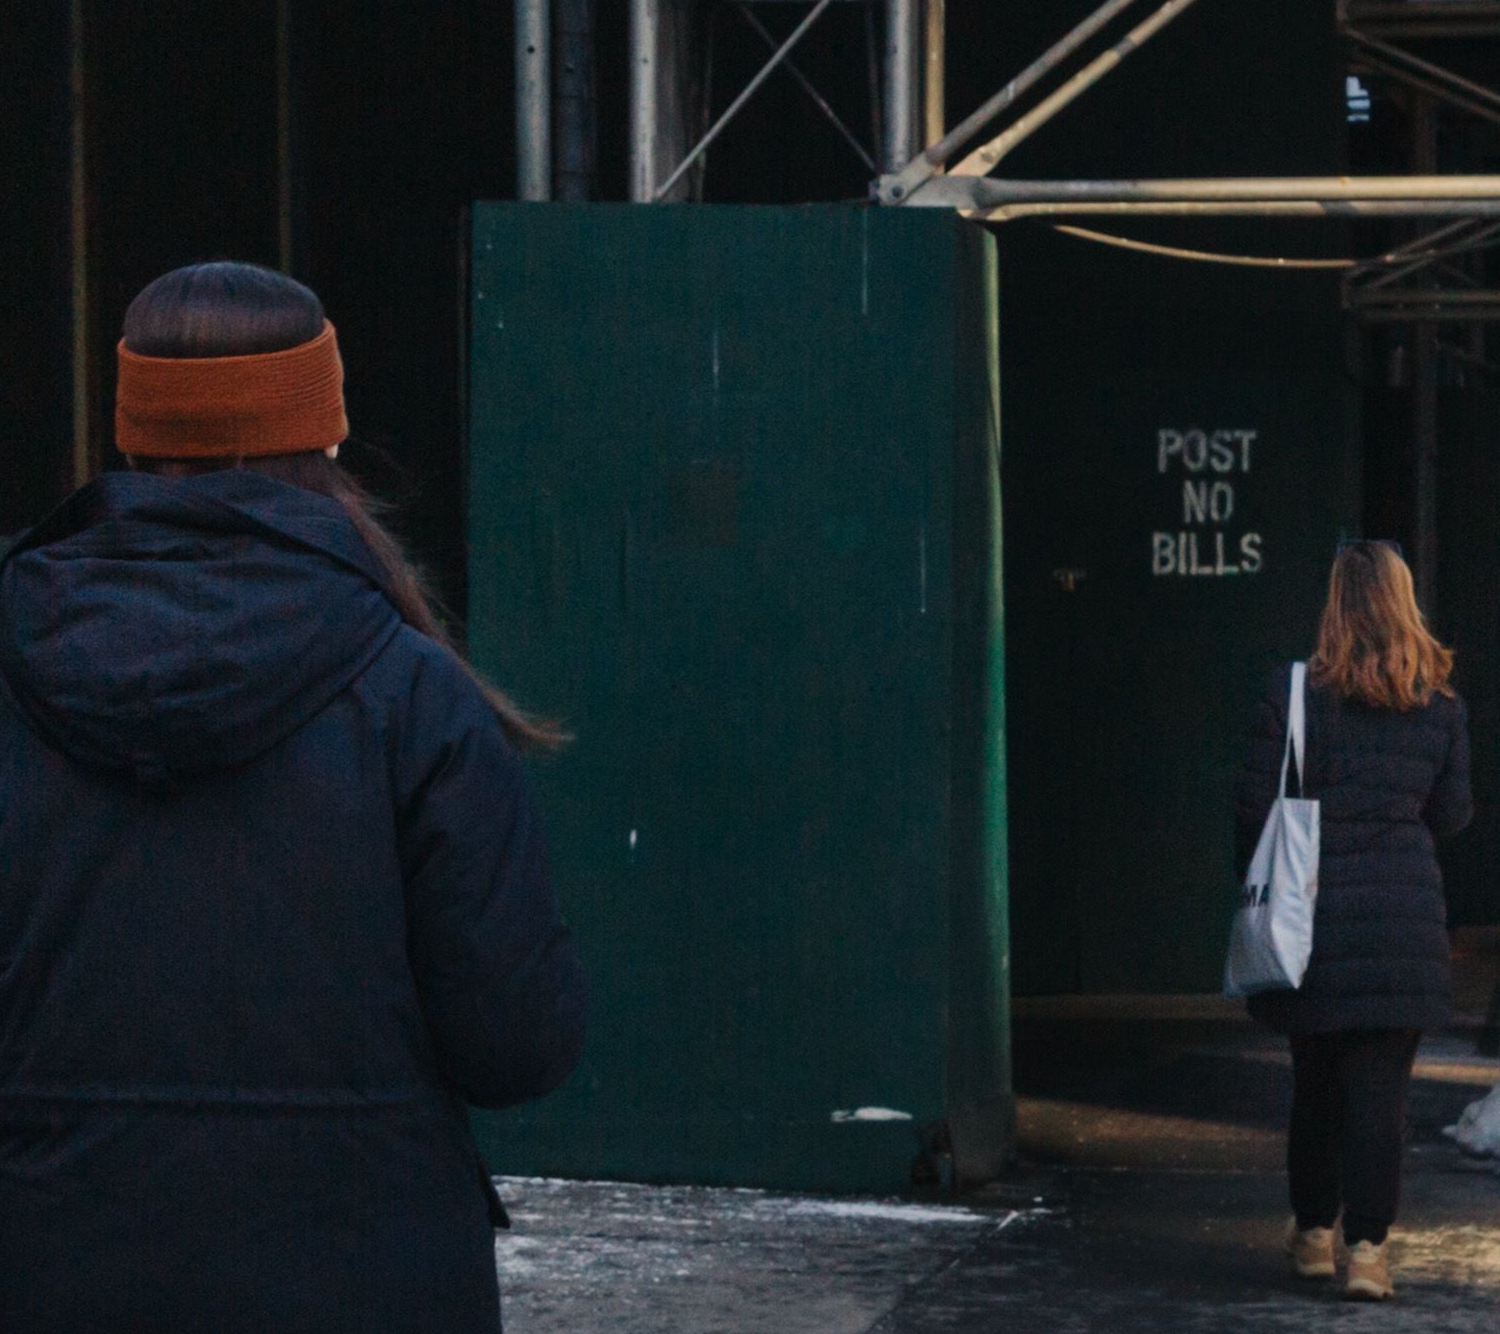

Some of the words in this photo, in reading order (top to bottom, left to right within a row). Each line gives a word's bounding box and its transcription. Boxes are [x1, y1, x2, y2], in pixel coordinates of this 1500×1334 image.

[1157, 428, 1258, 473] POST
[1182, 480, 1235, 524] NO
[1152, 531, 1263, 576] BILLS
